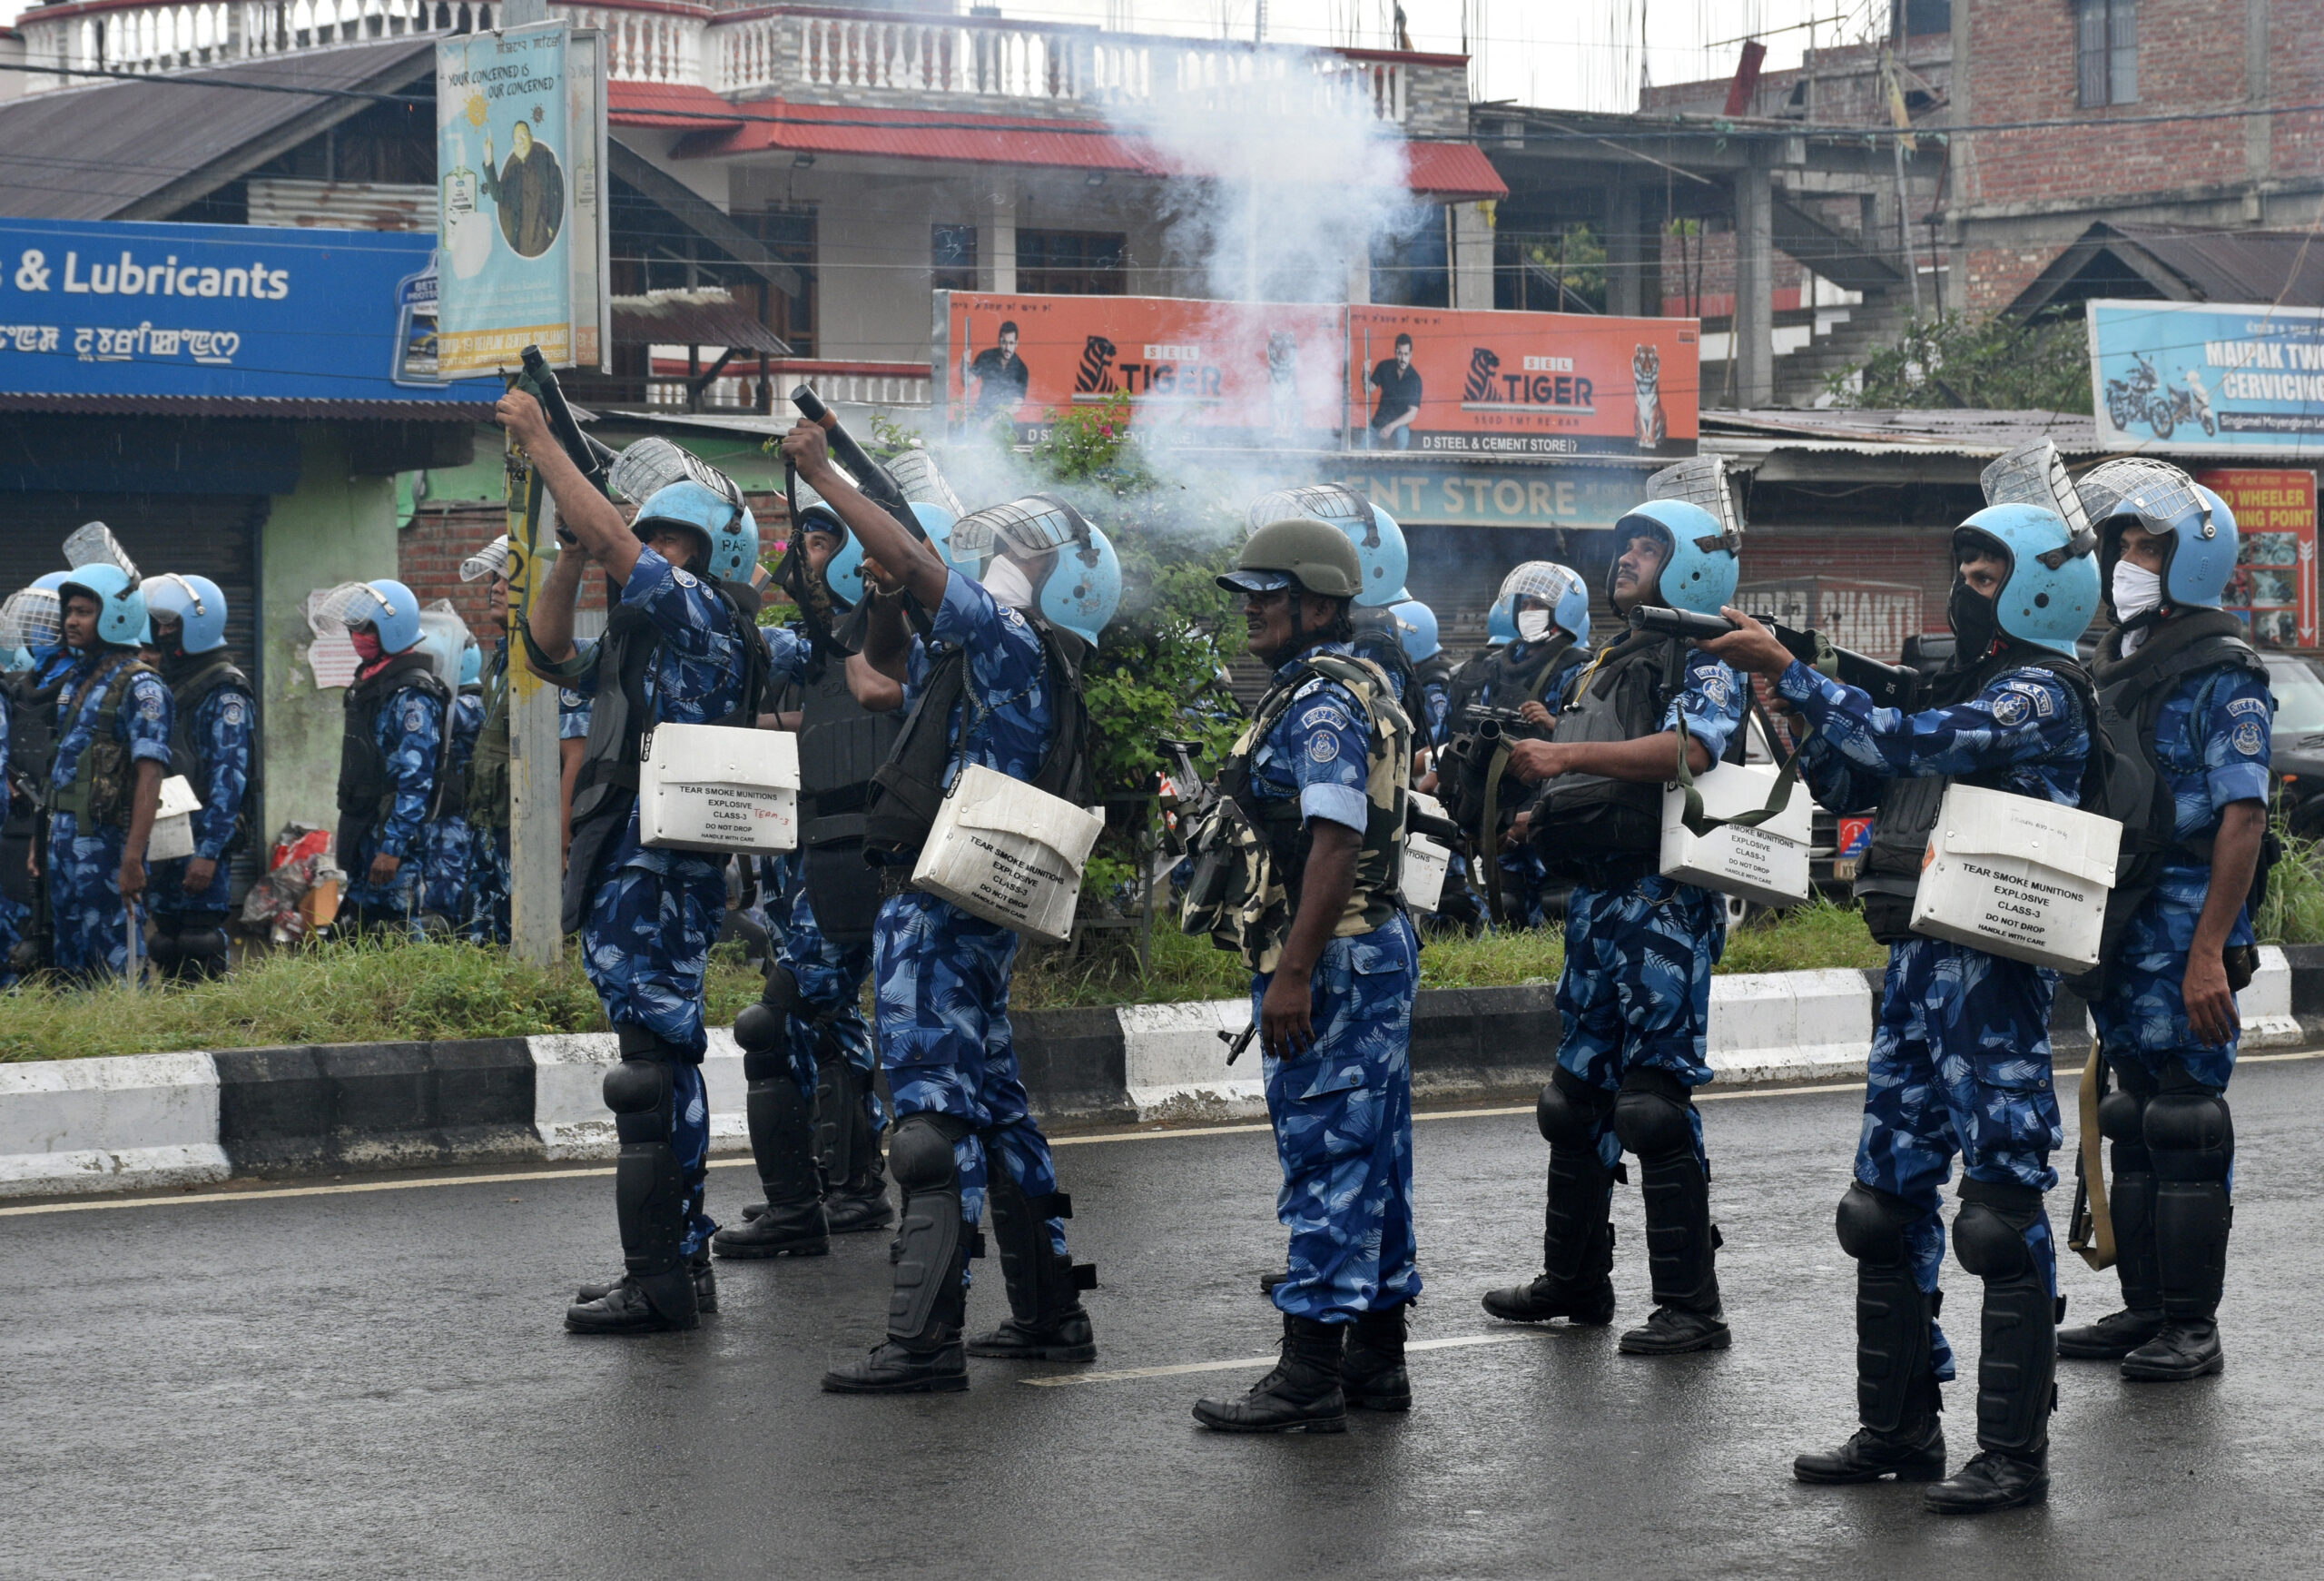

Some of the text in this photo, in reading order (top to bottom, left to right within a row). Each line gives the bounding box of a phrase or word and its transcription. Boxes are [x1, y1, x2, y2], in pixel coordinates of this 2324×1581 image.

[472, 64, 518, 84] CONCERNED
[521, 64, 530, 77] IS
[488, 77, 554, 98] OUR CONCERNED
[15, 249, 289, 300] & Lubricants
[2205, 341, 2324, 371] MAIPAK TW
[1119, 363, 1222, 396] TIGER
[1502, 375, 1594, 406] TIGER
[1434, 437, 1469, 450] STEEL
[1471, 438, 1480, 450] &
[1482, 438, 1528, 451] CEMENT
[1531, 439, 1567, 452] STORE
[1443, 478, 1577, 516] STORE
[2238, 489, 2306, 507] WHEELER
[2270, 509, 2313, 527] POINT
[1820, 591, 1915, 654] SHAKTI
[680, 786, 777, 801] TEAR SMOKE MUNITIONS
[708, 799, 753, 809] EXPLOSIVE
[714, 811, 747, 820] CLASS-3
[734, 825, 752, 833] DROP
[1729, 823, 1794, 849] SMOKE MUNITIONS
[1731, 835, 1771, 852] EXPLOSIVE
[970, 835, 1064, 885] TEAR SMOKE MUNITIONS
[1404, 849, 1431, 863] ITIONS
[1736, 847, 1766, 862] CLASS-3
[992, 861, 1039, 887] EXPLOSIVE
[1725, 867, 1771, 885] HANDLE WITH CARE
[1728, 857, 1770, 874] DO NOT DROP
[992, 875, 1028, 896] CLASS-3
[1963, 863, 2083, 903] TEAR SMOKE MUNITIONS
[971, 891, 1027, 921] HANDLE WITH CARE
[980, 883, 1029, 910] DO NOT DROP
[1994, 884, 2050, 907] EXPLOSIVE
[1997, 900, 2041, 918] CLASS-3
[1985, 913, 2045, 934] DO NOT DROP
[1977, 924, 2046, 947] HANDLE WITH CARE
